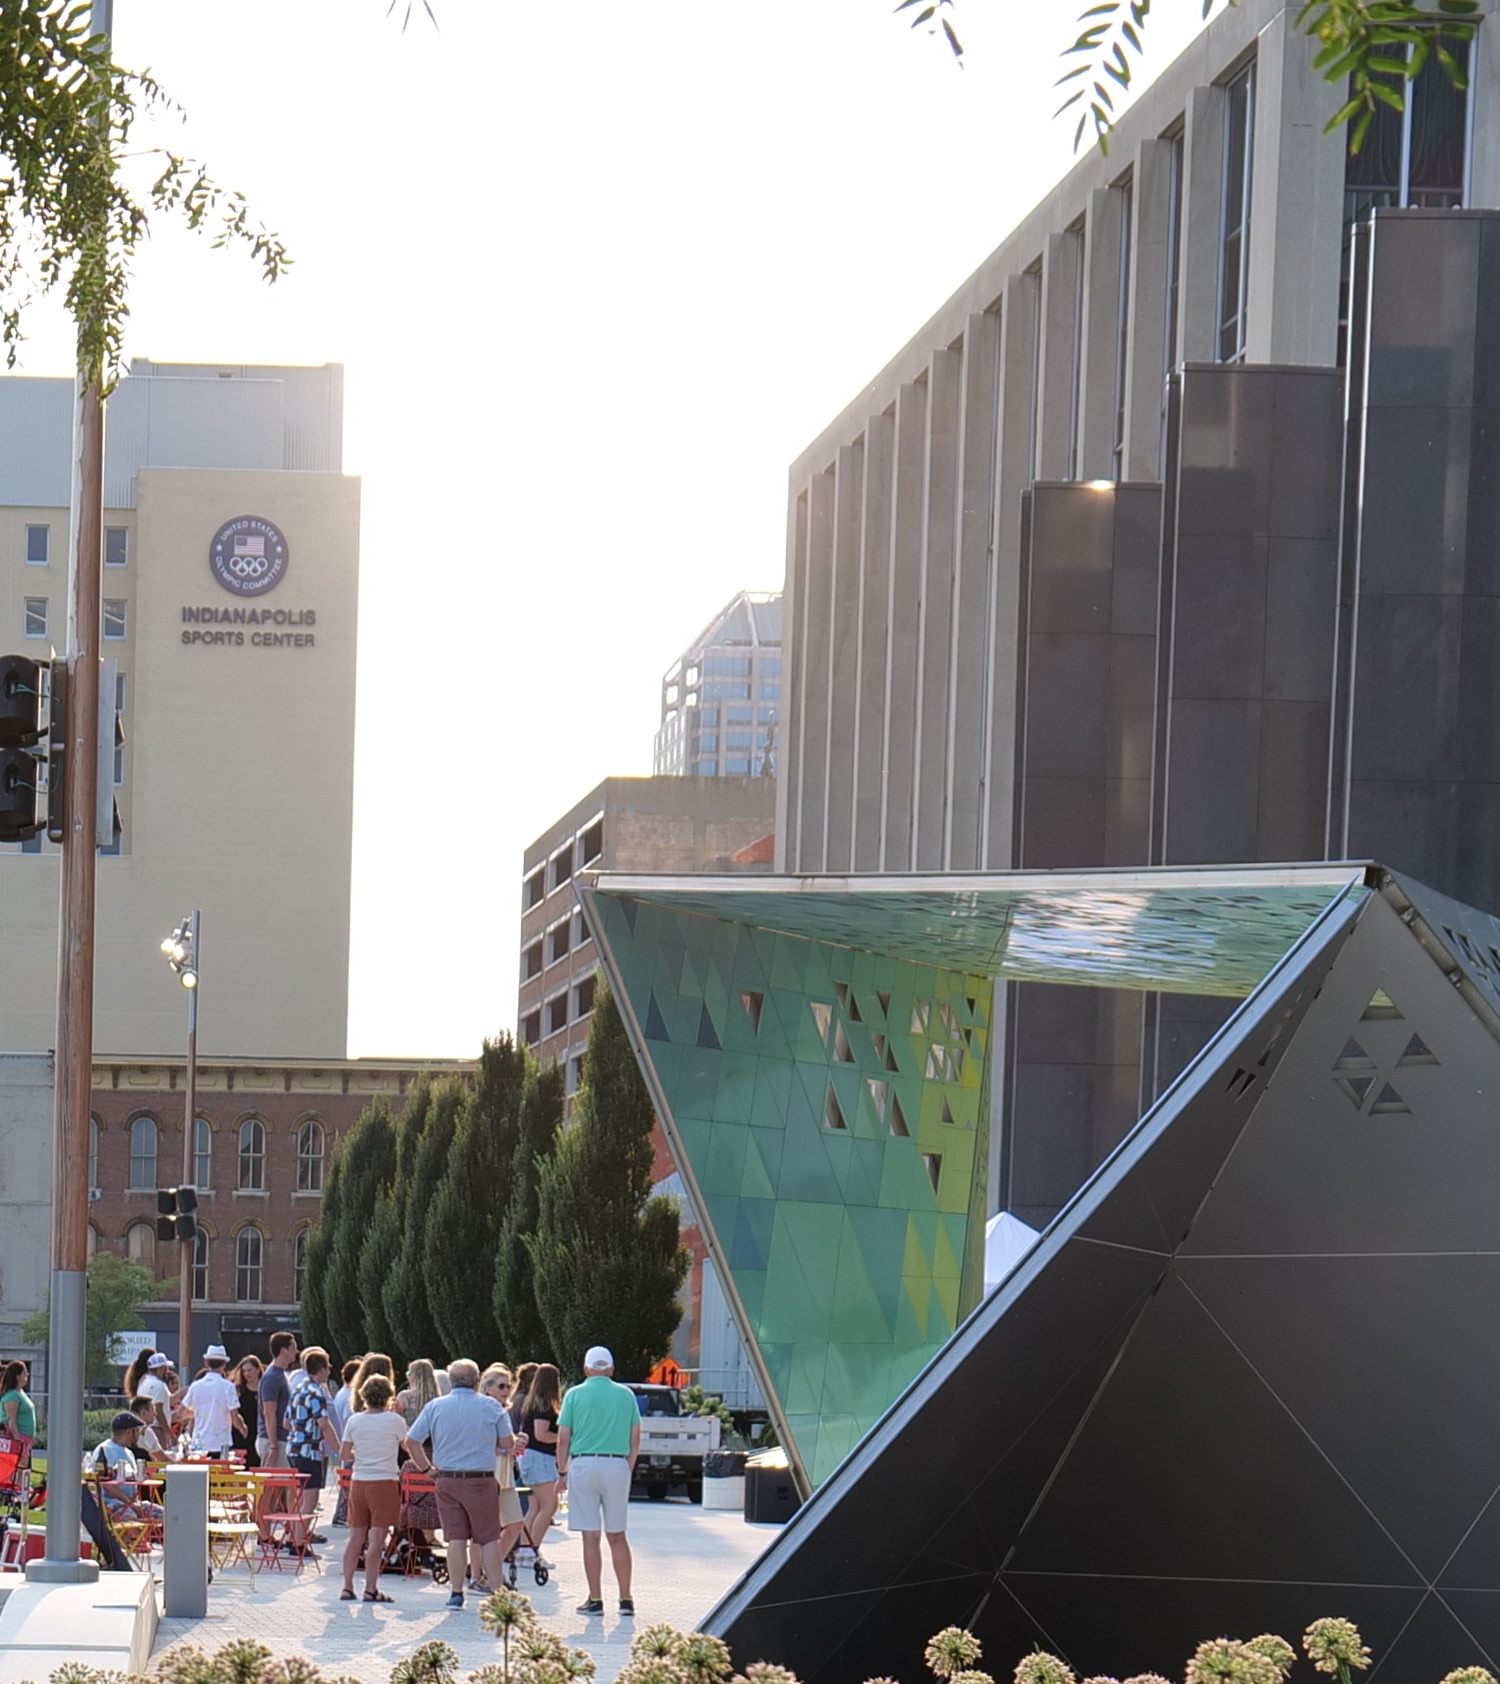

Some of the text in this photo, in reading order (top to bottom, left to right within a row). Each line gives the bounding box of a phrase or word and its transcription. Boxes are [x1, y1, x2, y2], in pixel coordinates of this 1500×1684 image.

[221, 520, 279, 542] UNITED STATES
[215, 555, 283, 590] OLYMPIC COMMITTEE
[181, 606, 317, 626] INDIANAPOLIS
[181, 630, 316, 647] SPORTS CENTER
